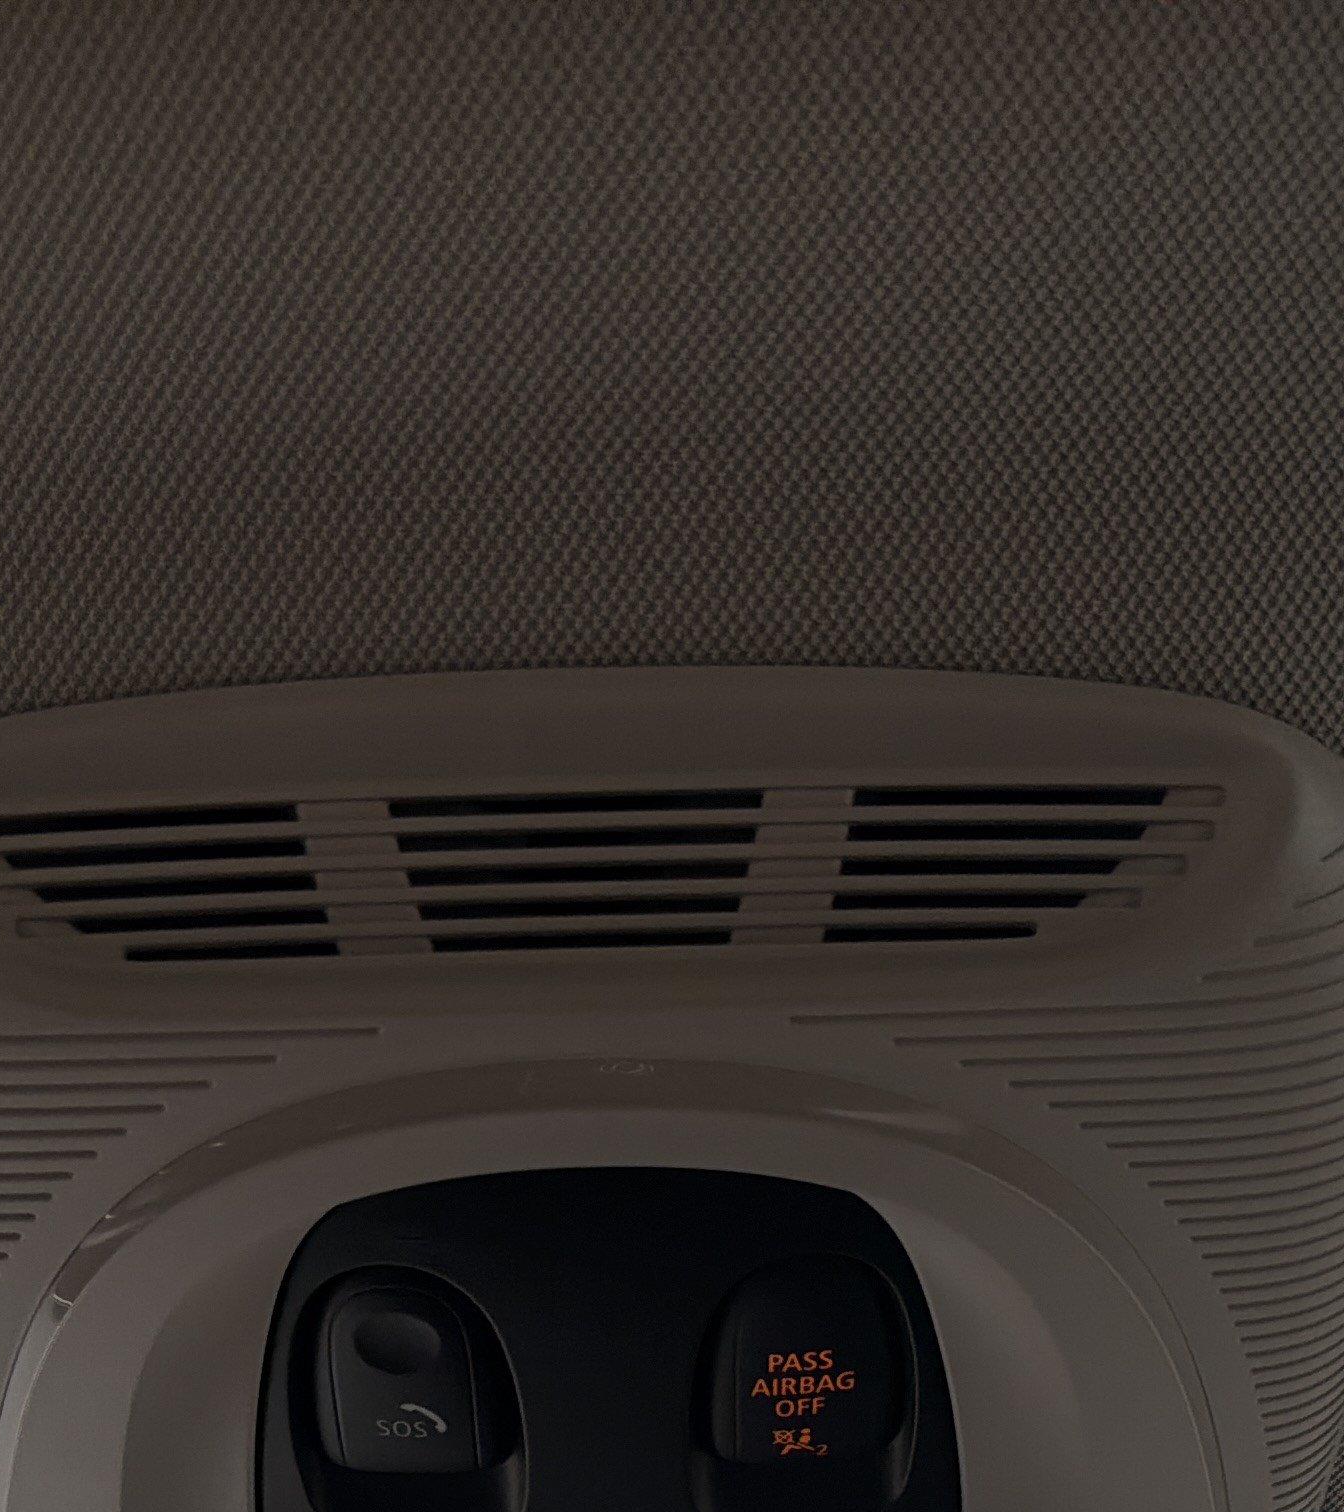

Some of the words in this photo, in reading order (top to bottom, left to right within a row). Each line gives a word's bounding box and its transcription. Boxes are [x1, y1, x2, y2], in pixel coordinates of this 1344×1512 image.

[767, 1350, 833, 1373] PASS
[751, 1371, 856, 1397] AIRBAG
[775, 1396, 826, 1417] OFF
[376, 1419, 428, 1439] SOS
